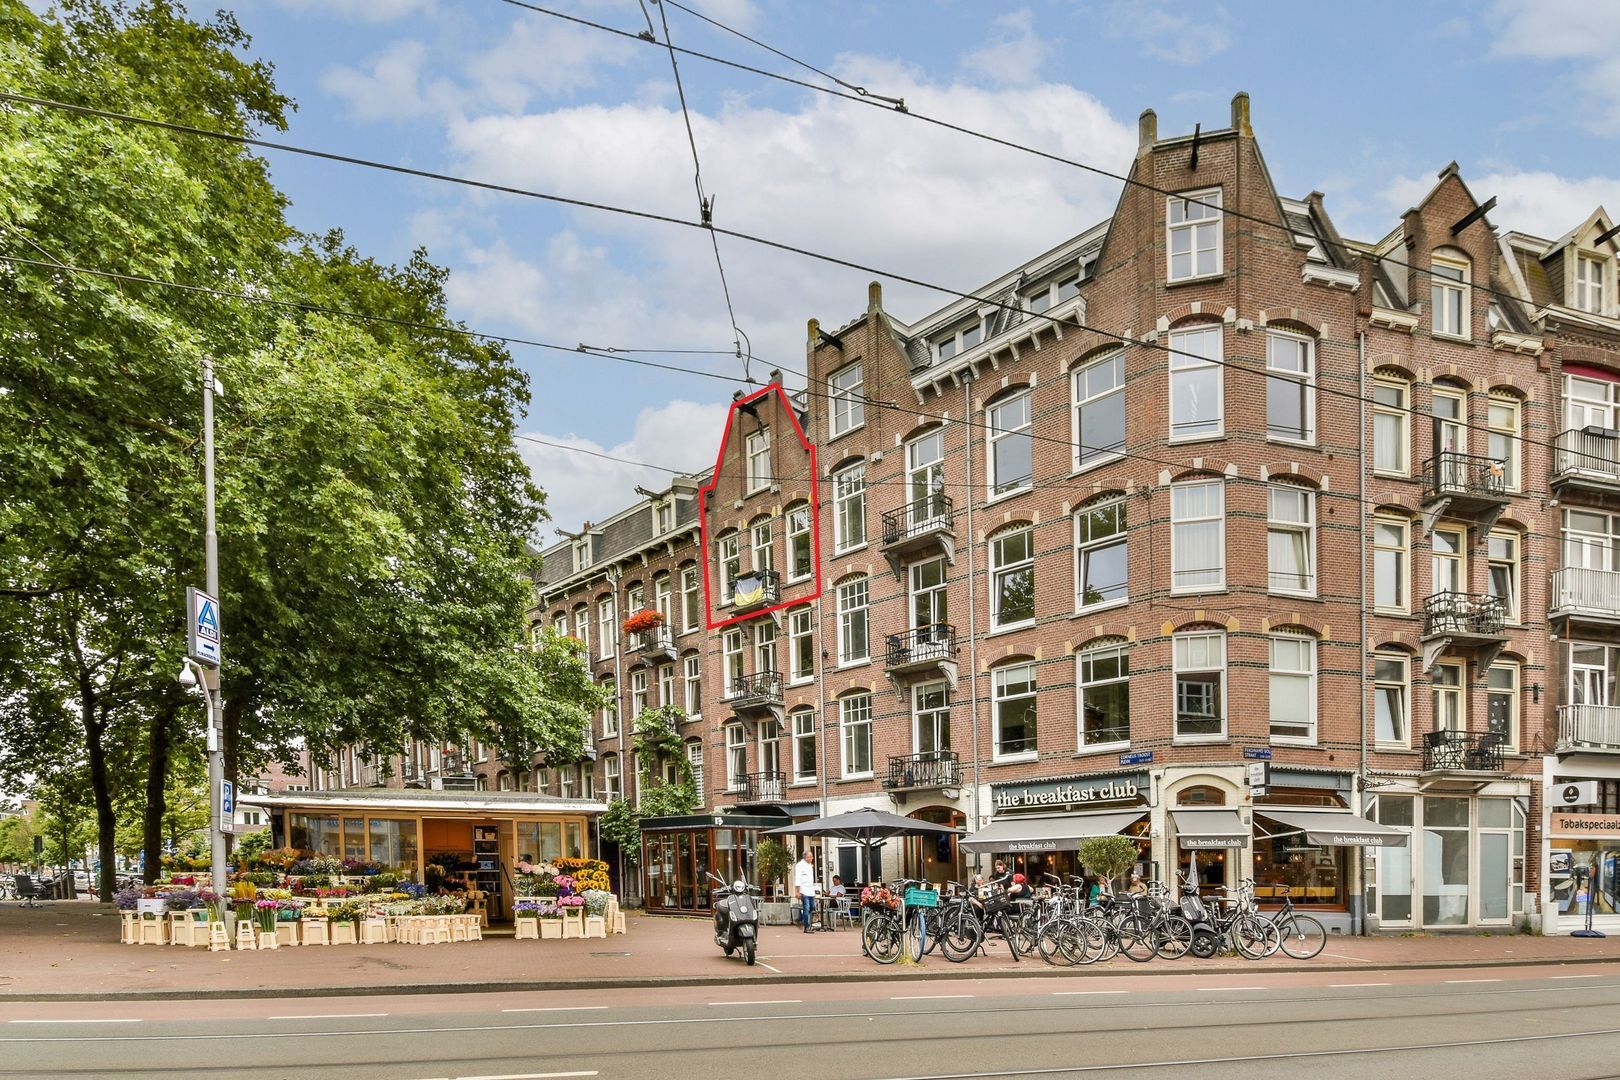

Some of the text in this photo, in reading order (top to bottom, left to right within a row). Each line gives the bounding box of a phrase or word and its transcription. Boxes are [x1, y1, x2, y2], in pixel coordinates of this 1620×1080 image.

[200, 626, 217, 639] ALDI
[997, 780, 1138, 807] the breakfast club
[1043, 841, 1057, 849] club
[1343, 835, 1370, 843] breakfast
[1370, 836, 1383, 844] club
